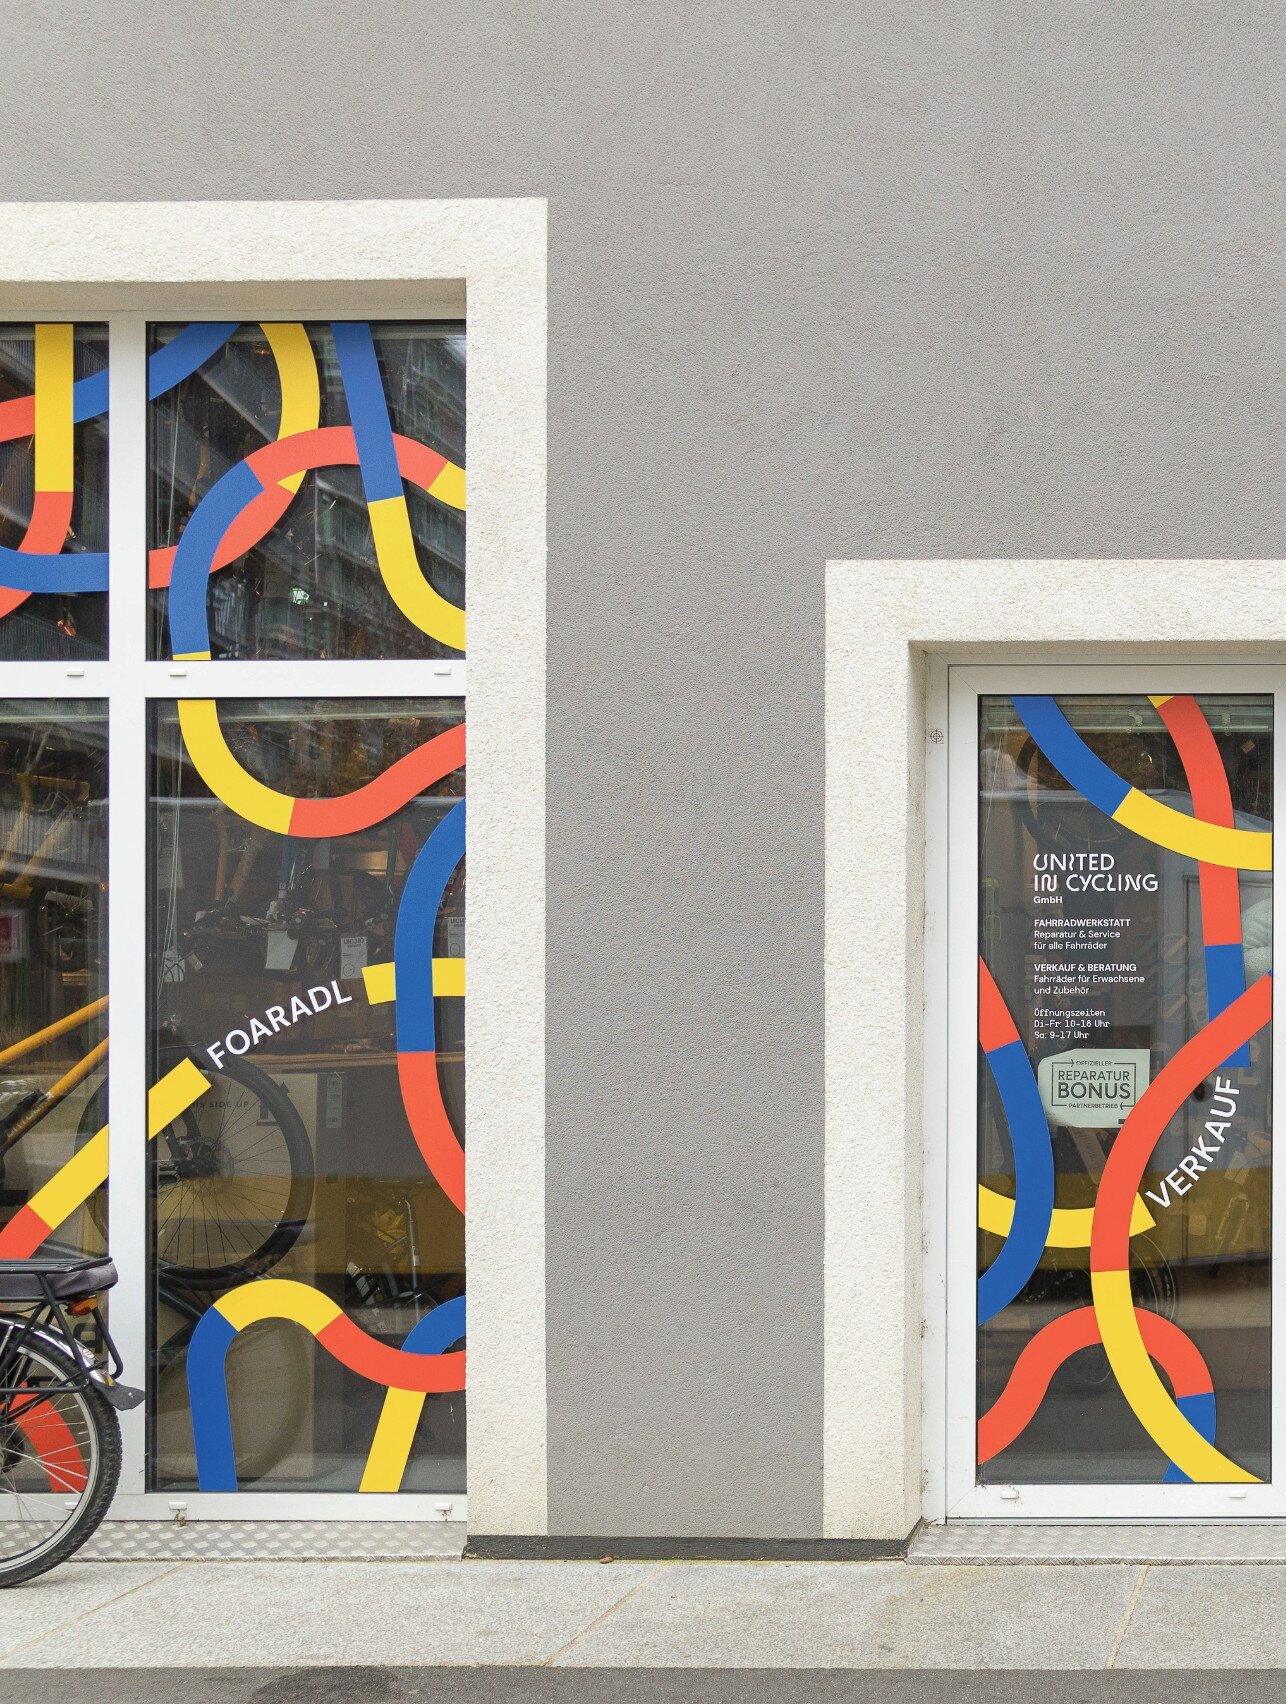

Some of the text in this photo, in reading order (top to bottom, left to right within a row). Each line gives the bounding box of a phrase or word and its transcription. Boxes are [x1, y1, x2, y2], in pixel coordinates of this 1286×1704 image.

[1033, 853, 1115, 872] UNITED
[1034, 873, 1159, 892] IN CYCLING
[1033, 896, 1063, 904] GmbH
[1034, 919, 1131, 927] FAHRRADWERKSTATT
[1034, 930, 1121, 940] Reparatur & Service
[1034, 941, 1108, 950] für alle Fahrräder
[1034, 963, 1137, 972] VERKAUF & BERATUNG
[1034, 974, 1145, 983] Fahrräder für Erwachsene
[1034, 985, 1090, 995] und Zubehör
[1034, 1007, 1106, 1018] Öffnungszeiten
[206, 980, 353, 1070] FOARADL
[1094, 1019, 1111, 1028] Uhr
[1034, 1031, 1047, 1039] Sa:
[1073, 1030, 1090, 1039] Uhr
[1058, 1070, 1130, 1081] REPARATUR
[1058, 1082, 1131, 1099] BONUS
[1145, 1076, 1240, 1208] VERKAUF
